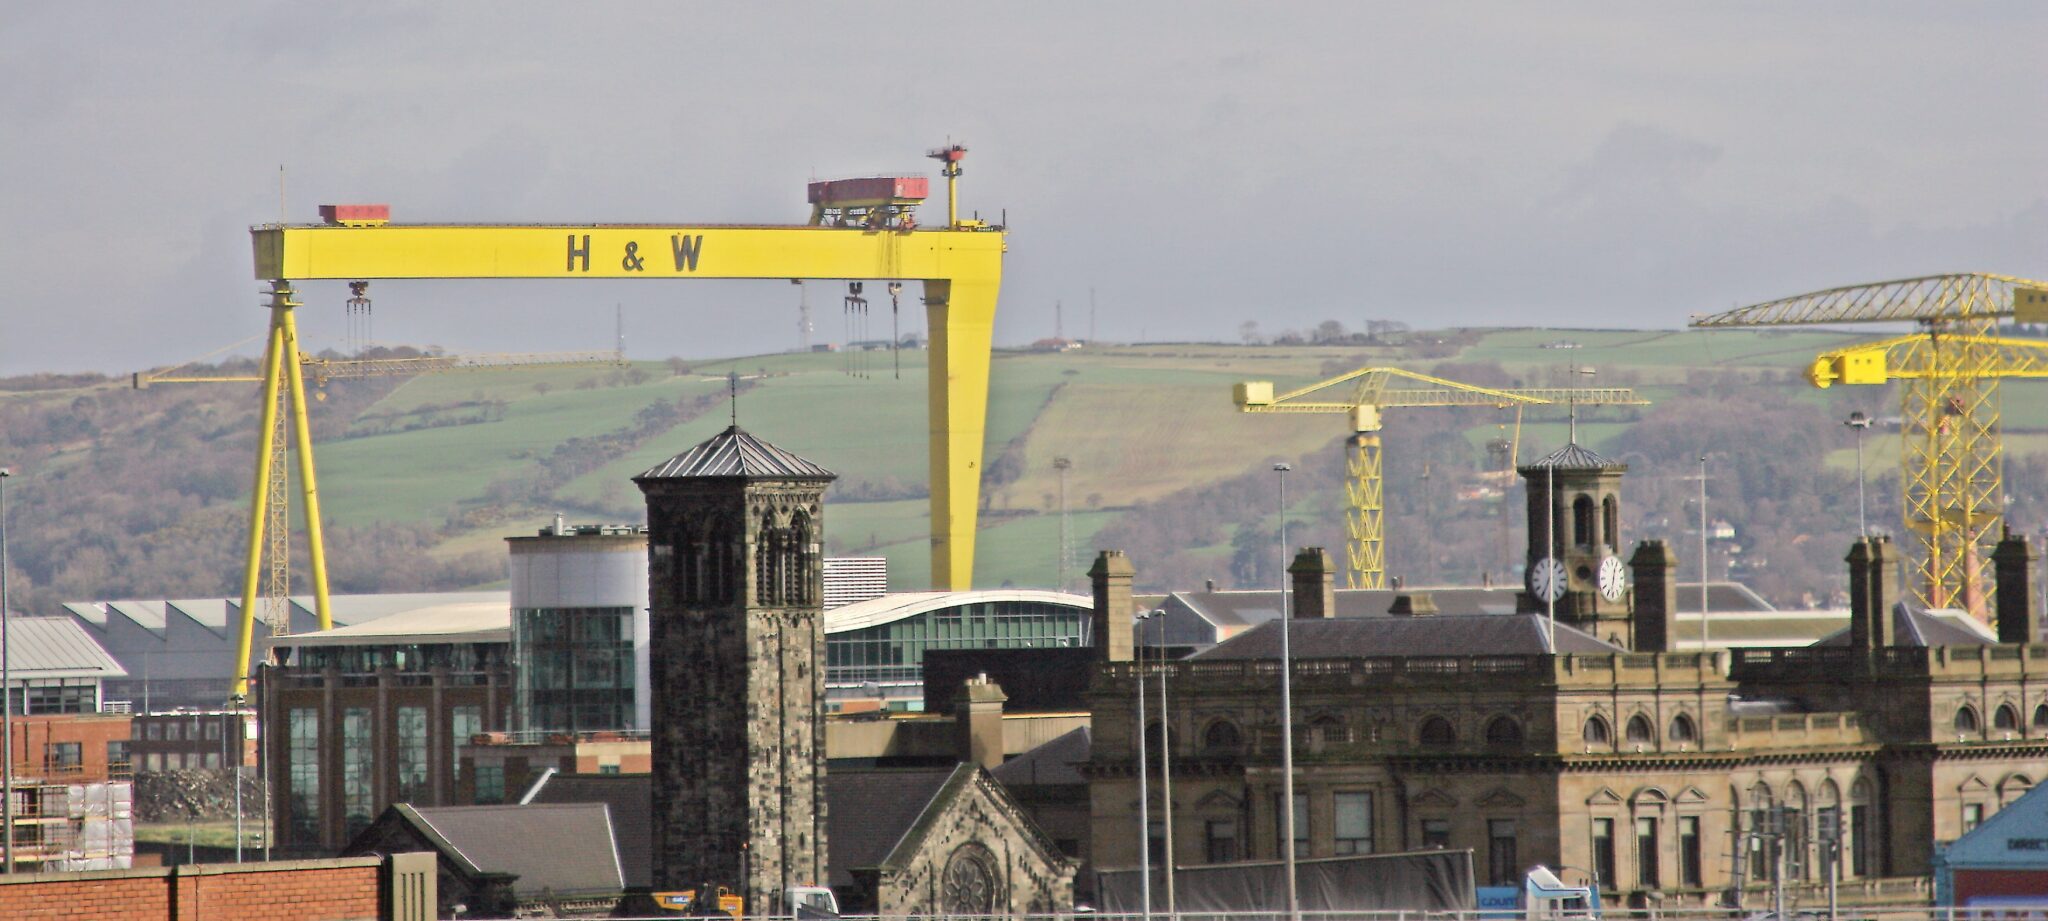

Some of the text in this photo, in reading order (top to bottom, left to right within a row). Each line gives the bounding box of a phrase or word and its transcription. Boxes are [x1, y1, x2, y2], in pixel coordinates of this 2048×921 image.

[567, 234, 703, 272] H & W
[2007, 838, 2048, 850] DIREC
